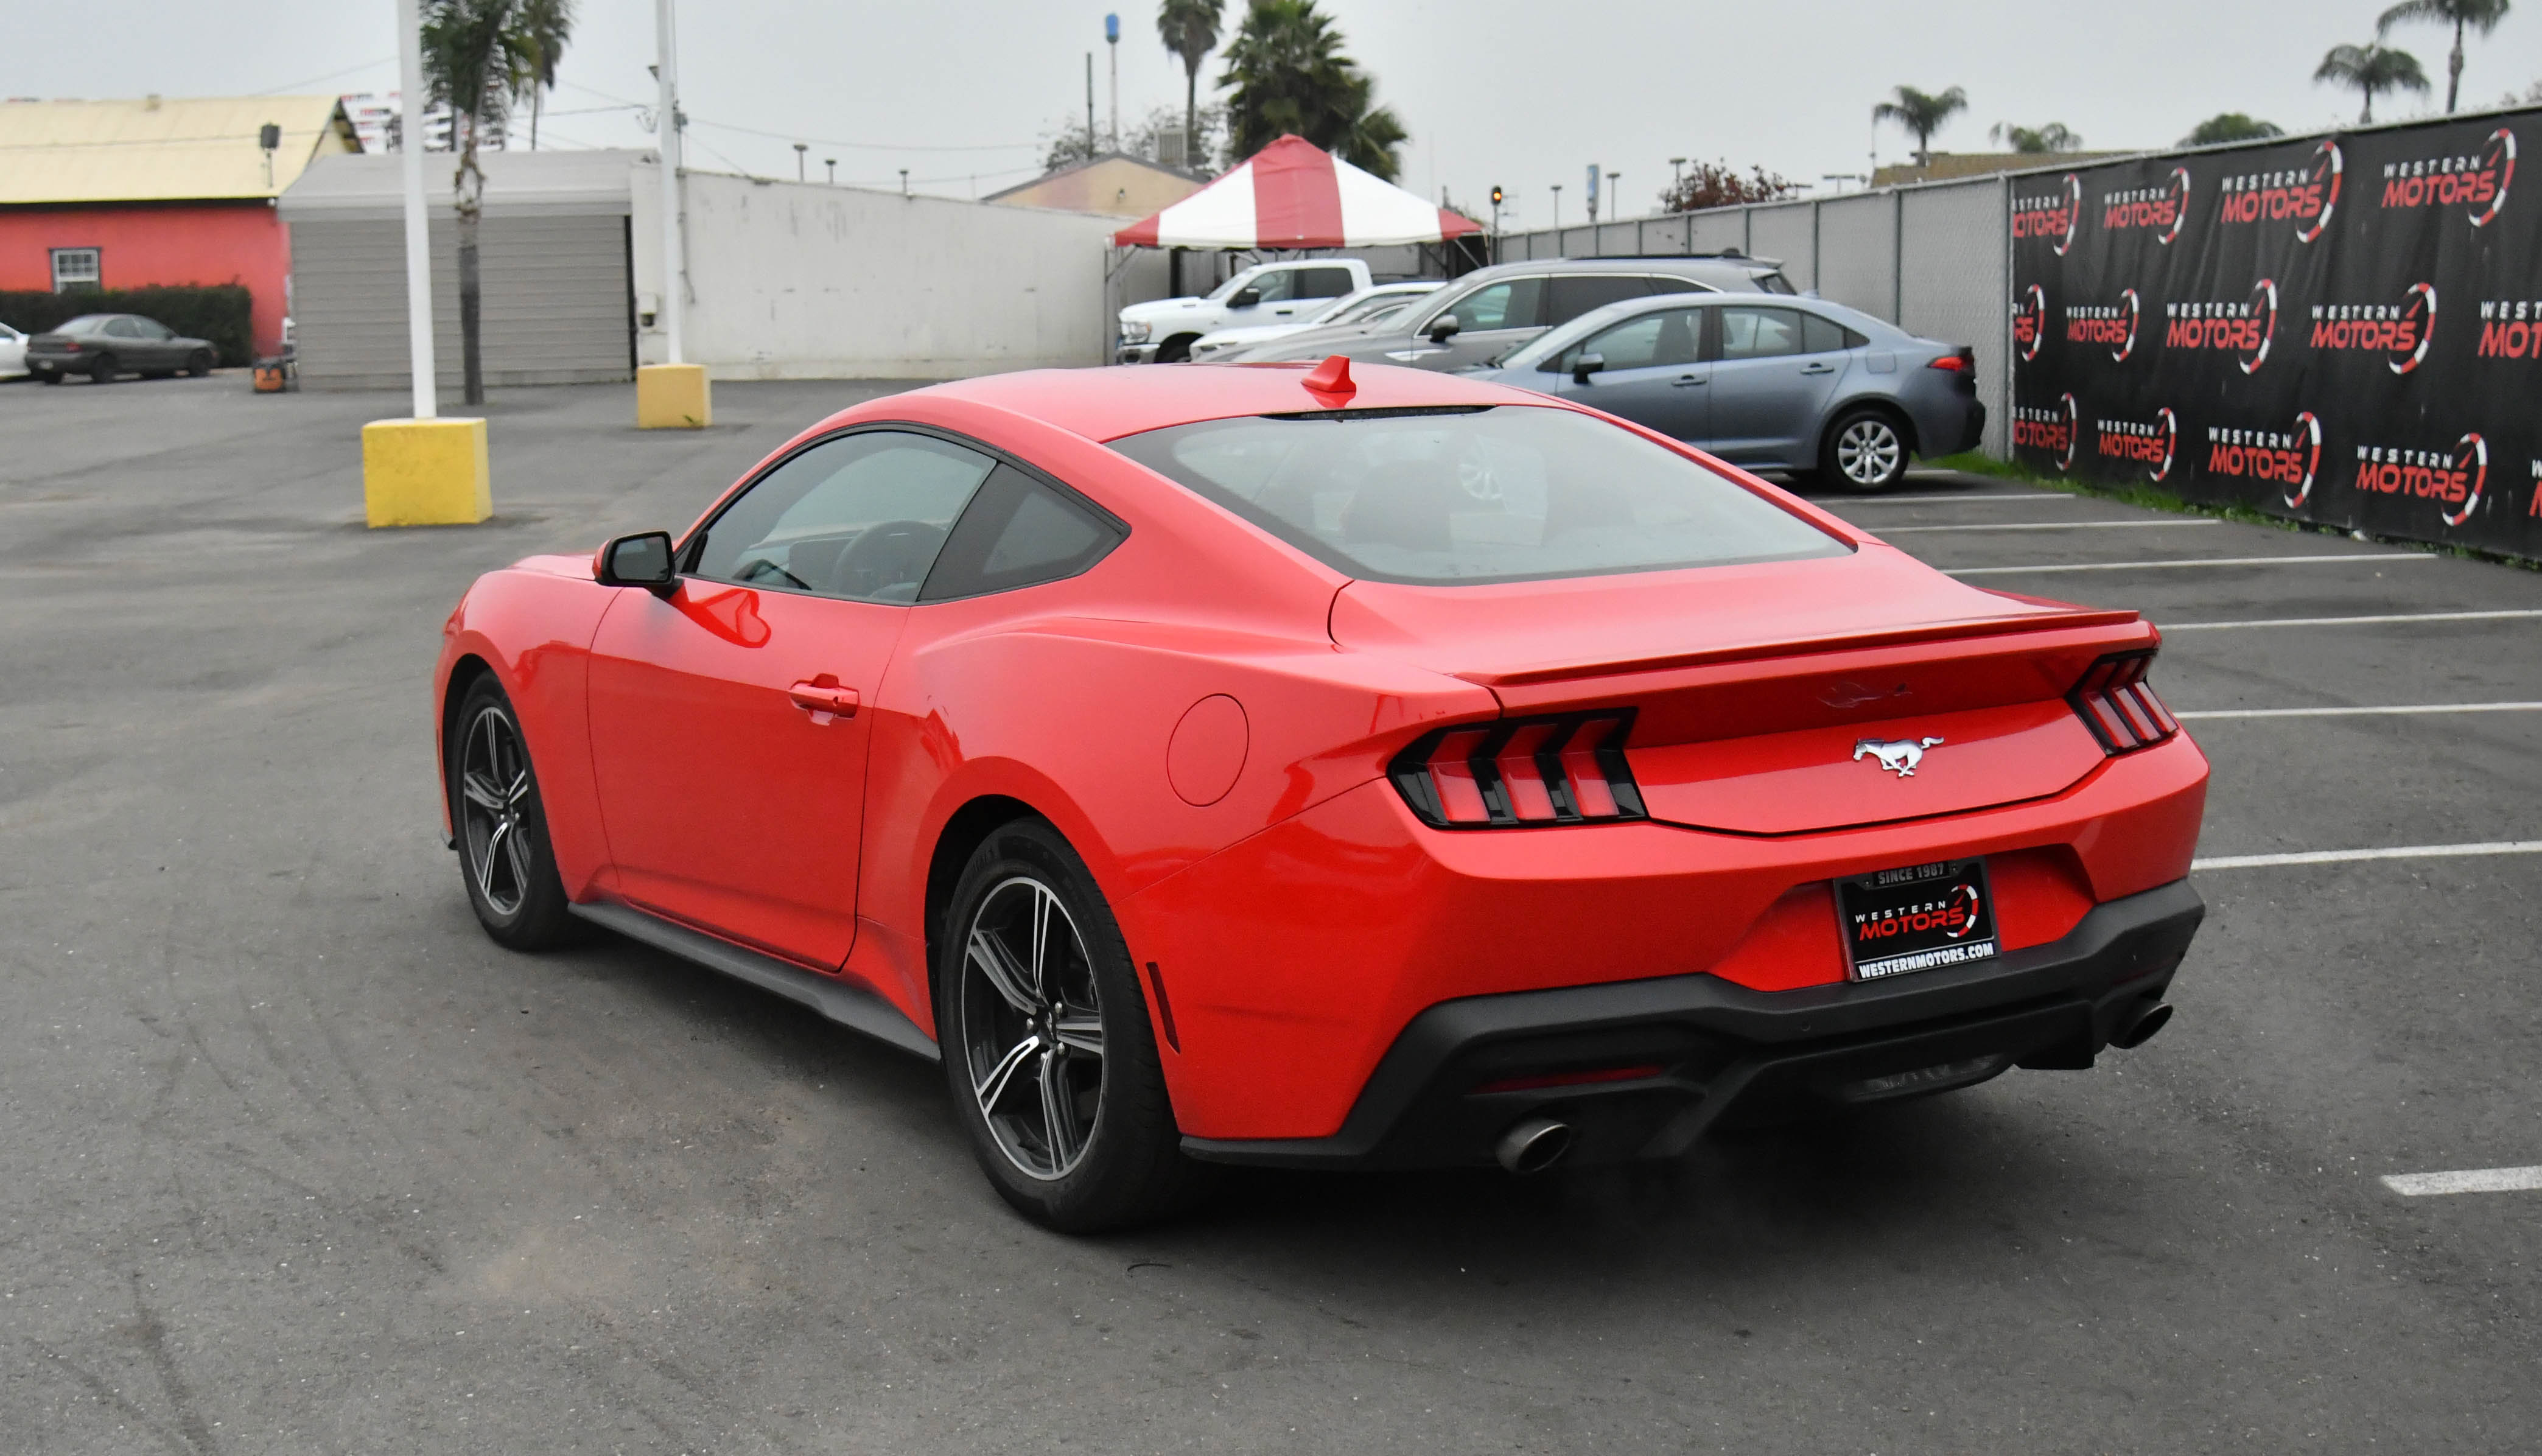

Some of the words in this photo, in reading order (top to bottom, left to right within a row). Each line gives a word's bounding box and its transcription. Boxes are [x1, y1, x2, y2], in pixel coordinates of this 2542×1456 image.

[2384, 156, 2479, 177] WESTERN
[2222, 169, 2308, 191] WESTERN
[2381, 170, 2496, 208] MOTORS
[2105, 188, 2165, 205] WESTERN
[2221, 184, 2322, 223] MOTORS
[2014, 208, 2068, 237] OTORS
[2104, 200, 2176, 229] MOTORS
[2067, 307, 2118, 318] WESTERN
[2168, 303, 2249, 318] WESTERN
[2313, 306, 2400, 320] WESTERN
[2067, 318, 2127, 343] MOTORS
[2166, 318, 2260, 349] MOTORS
[2311, 320, 2417, 351] MOTORS
[2098, 421, 2153, 435] WESTERN
[2209, 428, 2290, 447] WESTERN
[2099, 433, 2165, 463] MOTORS
[2358, 446, 2452, 467] WESTERN
[2208, 444, 2303, 484] MOTORS
[2356, 461, 2468, 502] MOTORS
[1878, 867, 1913, 884] SINCE
[1917, 863, 1944, 878] 1987
[1856, 901, 1945, 922] WESTERN
[1860, 906, 1966, 940] MOTORS
[1859, 943, 1994, 979] WESTERNMOTORS.COM
